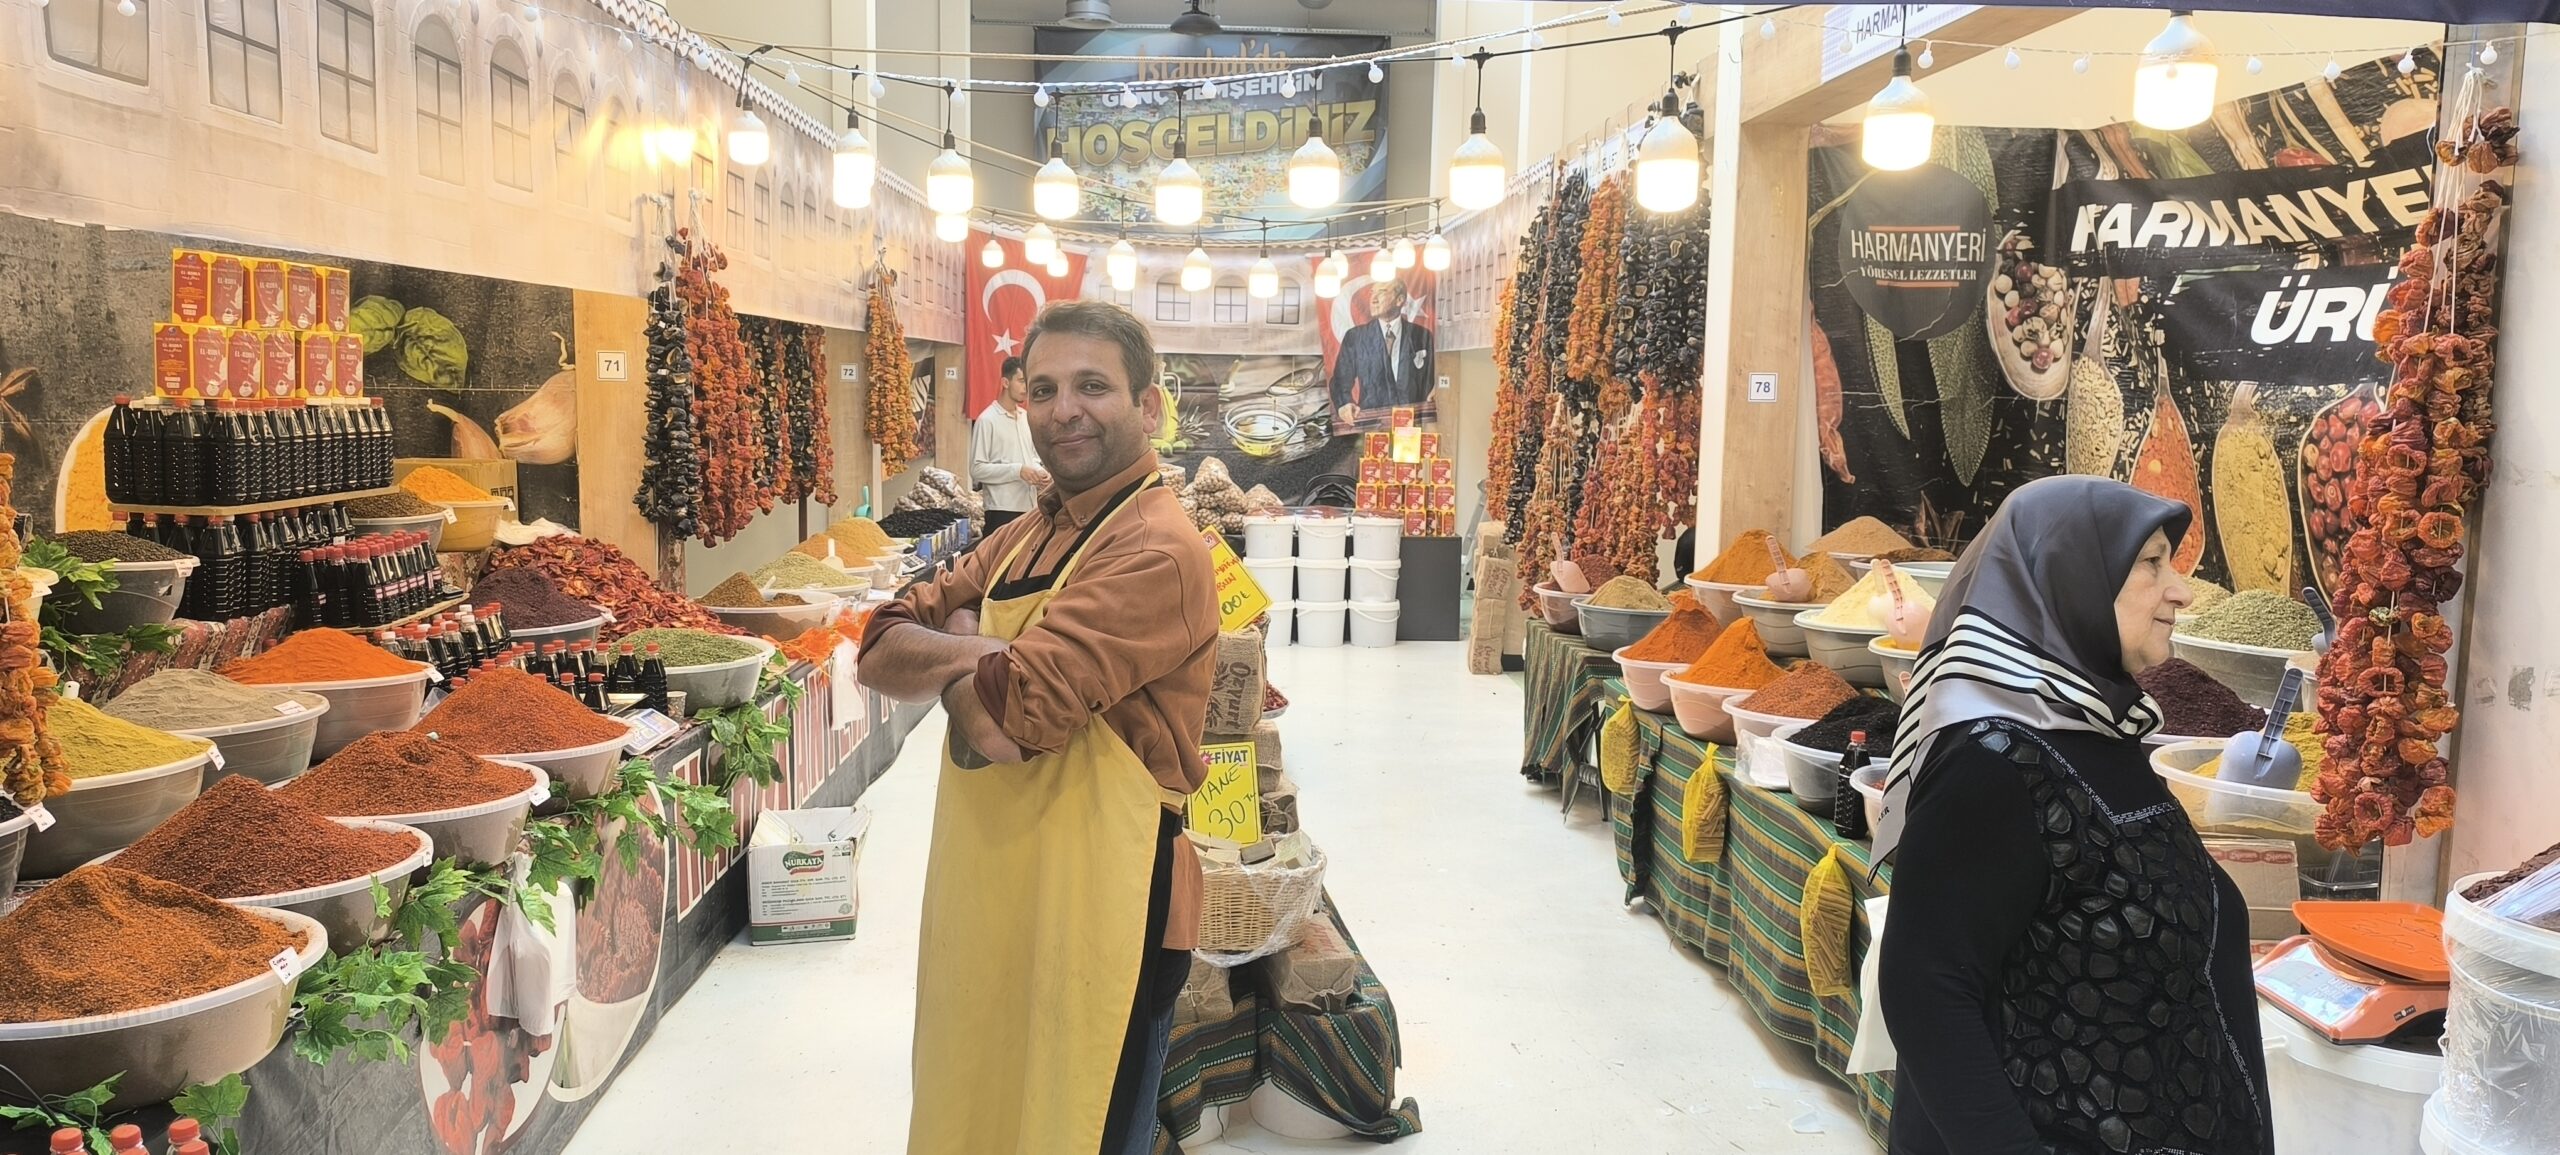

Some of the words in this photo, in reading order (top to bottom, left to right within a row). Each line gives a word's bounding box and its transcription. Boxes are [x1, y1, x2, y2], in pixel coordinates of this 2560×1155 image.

[1851, 227, 1987, 263] HARMANYERİ
[1860, 265, 1907, 280] YÖRESEL
[1909, 269, 1977, 281] LEZZETLER
[604, 360, 620, 371] 71
[843, 368, 854, 377] 72
[1755, 381, 1771, 393] 78
[1214, 748, 1249, 765] FİYAT
[1194, 763, 1241, 806] TANE
[784, 857, 824, 868] NURKAYA
